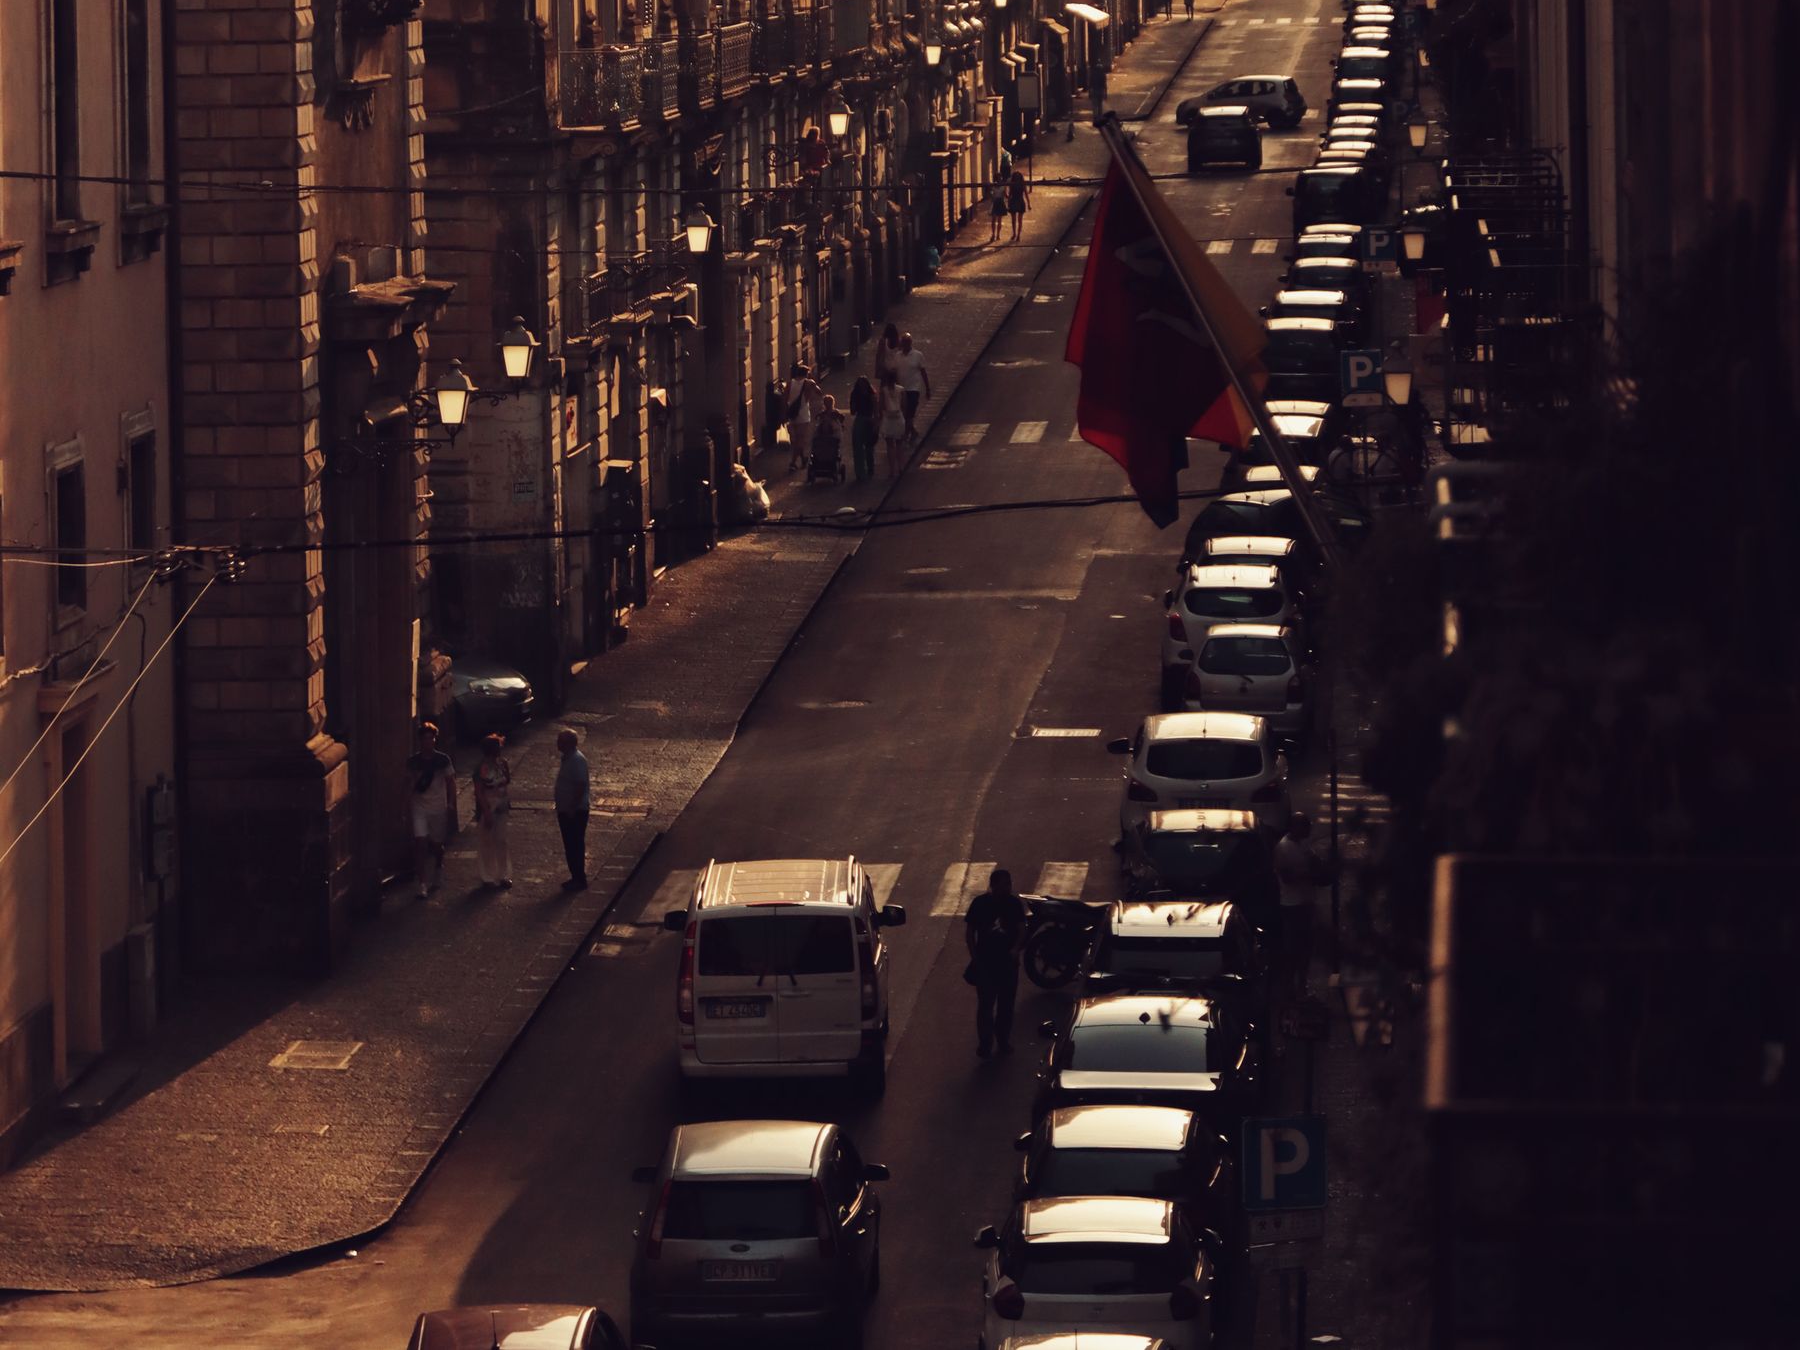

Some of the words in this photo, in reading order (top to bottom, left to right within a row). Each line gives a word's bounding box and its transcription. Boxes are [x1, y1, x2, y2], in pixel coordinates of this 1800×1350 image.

[1405, 15, 1415, 28] P
[1392, 103, 1408, 119] P
[1370, 230, 1390, 256] P
[1351, 355, 1374, 387] P
[1260, 1127, 1310, 1200] P
